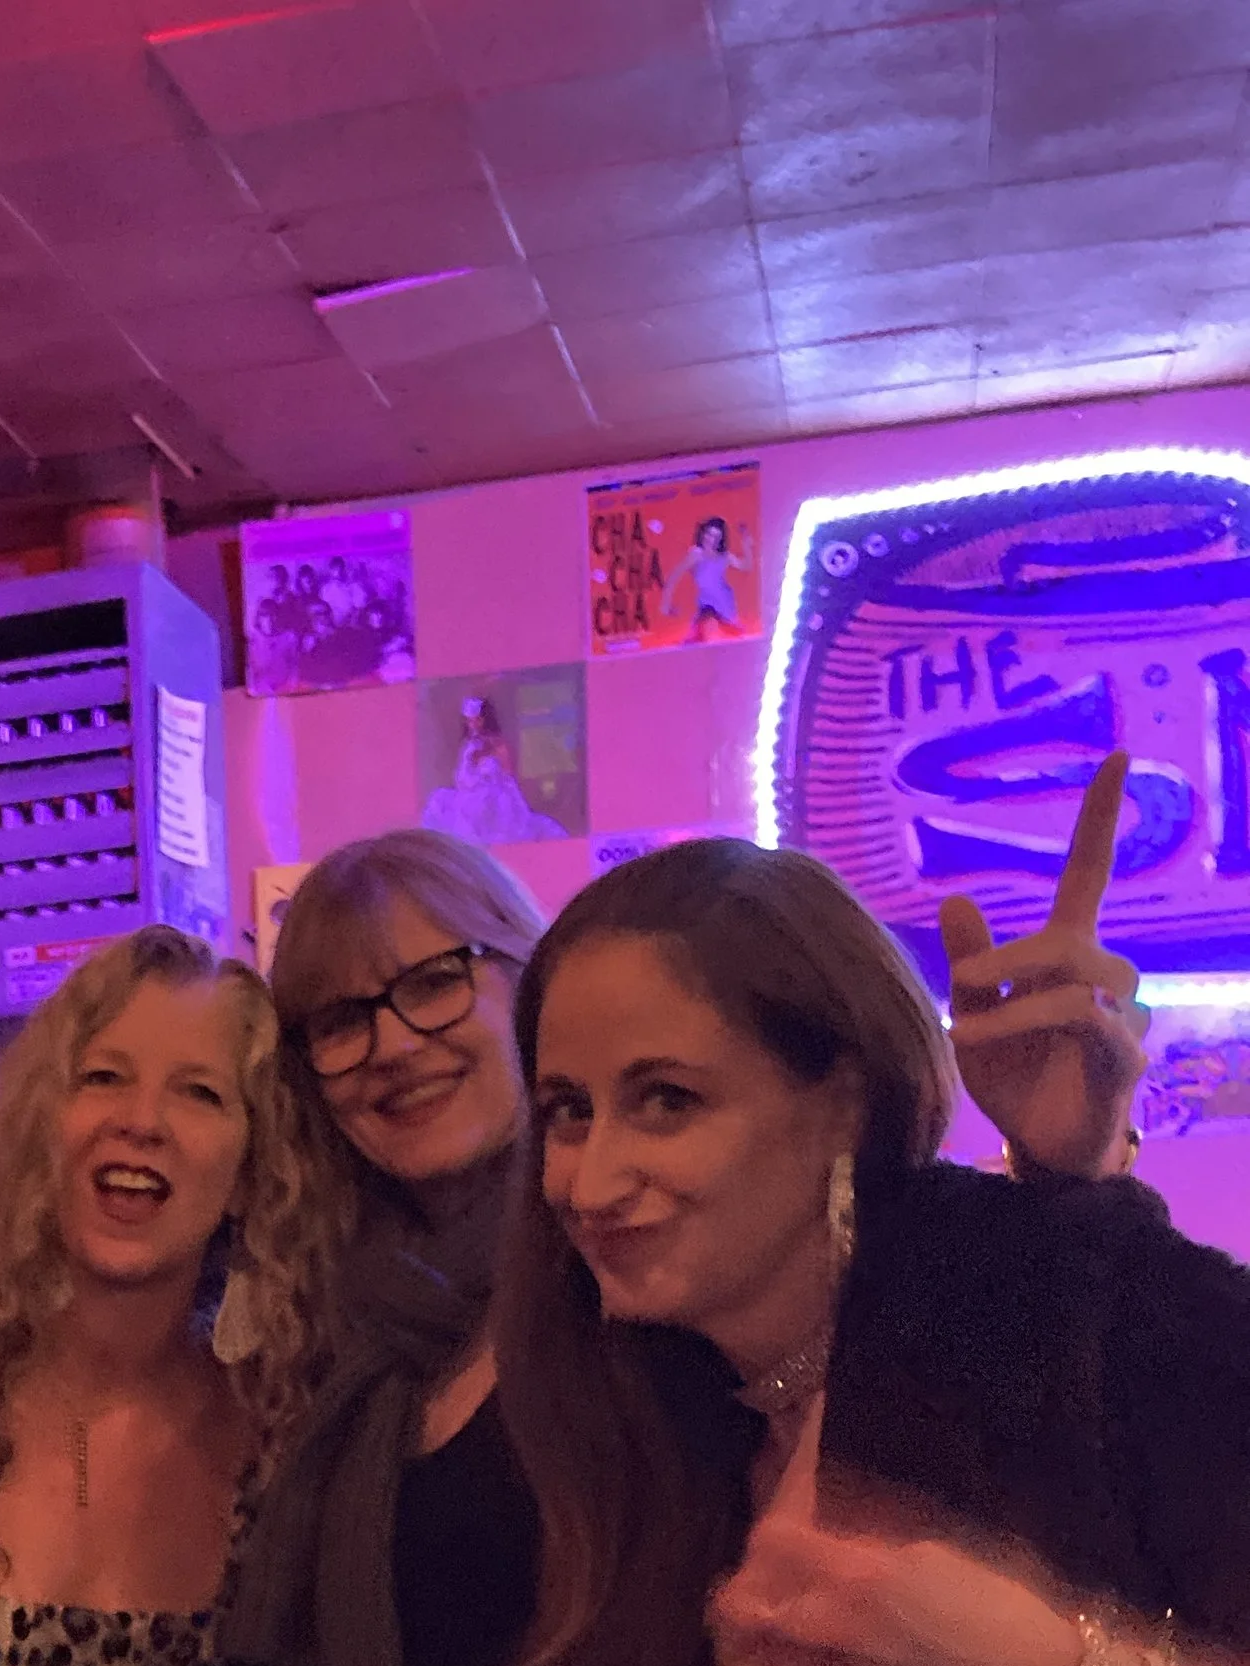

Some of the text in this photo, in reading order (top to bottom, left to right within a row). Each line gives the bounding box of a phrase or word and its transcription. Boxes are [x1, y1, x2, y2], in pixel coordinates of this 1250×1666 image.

[592, 511, 647, 556] CHA
[610, 549, 665, 593] CHA
[594, 592, 649, 637] CHA
[882, 629, 1059, 720] THE
